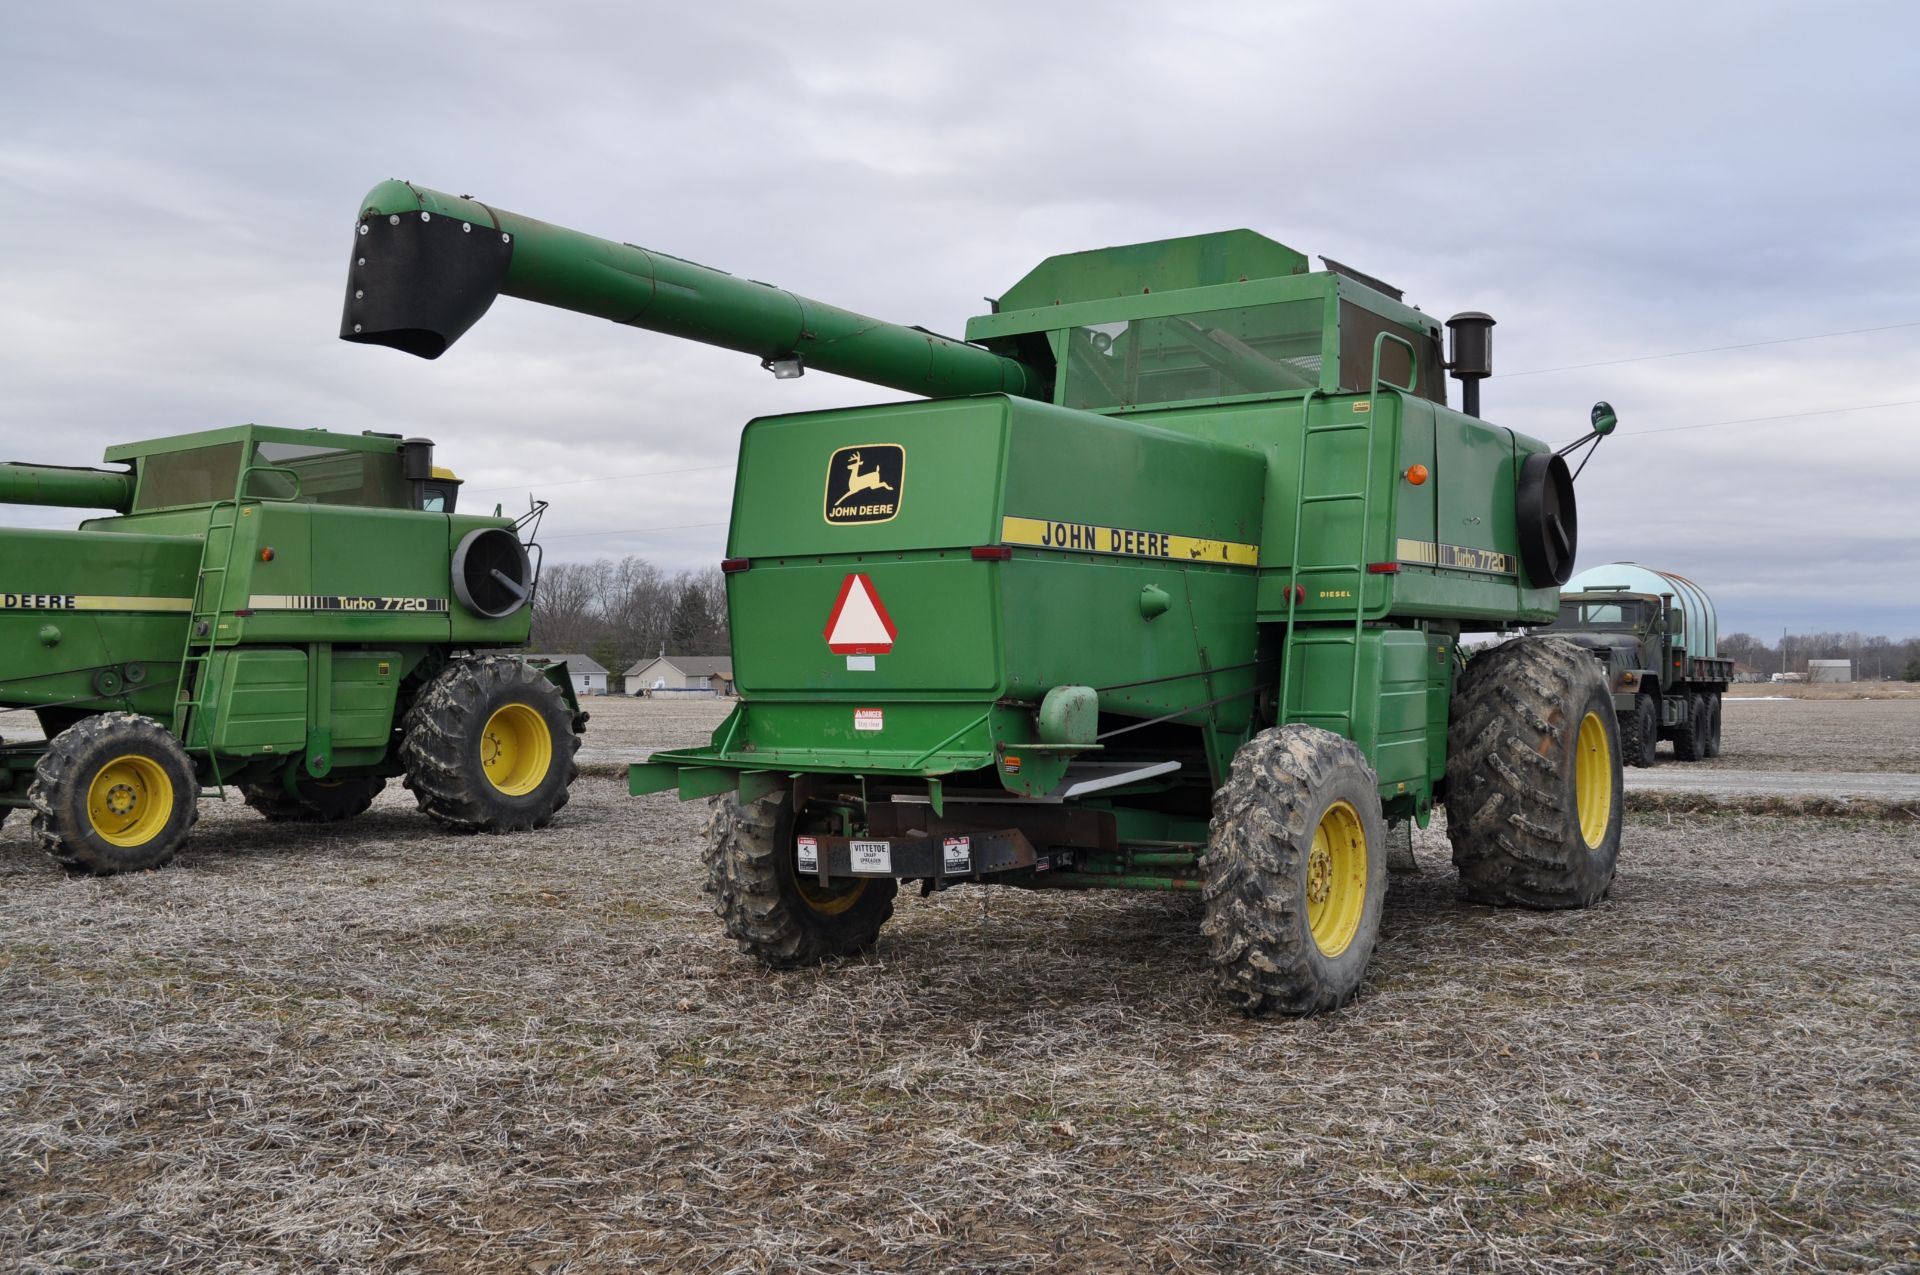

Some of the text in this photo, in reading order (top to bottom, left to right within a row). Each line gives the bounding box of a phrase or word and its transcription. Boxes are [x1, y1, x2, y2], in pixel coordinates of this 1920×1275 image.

[829, 504, 894, 518] JOHN DEERE
[1042, 521, 1169, 557] JOHN DEERE
[1453, 546, 1505, 572] Turbo 7720
[5, 594, 75, 609] DEERE
[338, 596, 428, 611] Turbo 7720
[861, 710, 882, 719] DANGER
[854, 844, 886, 853] VITTETOE
